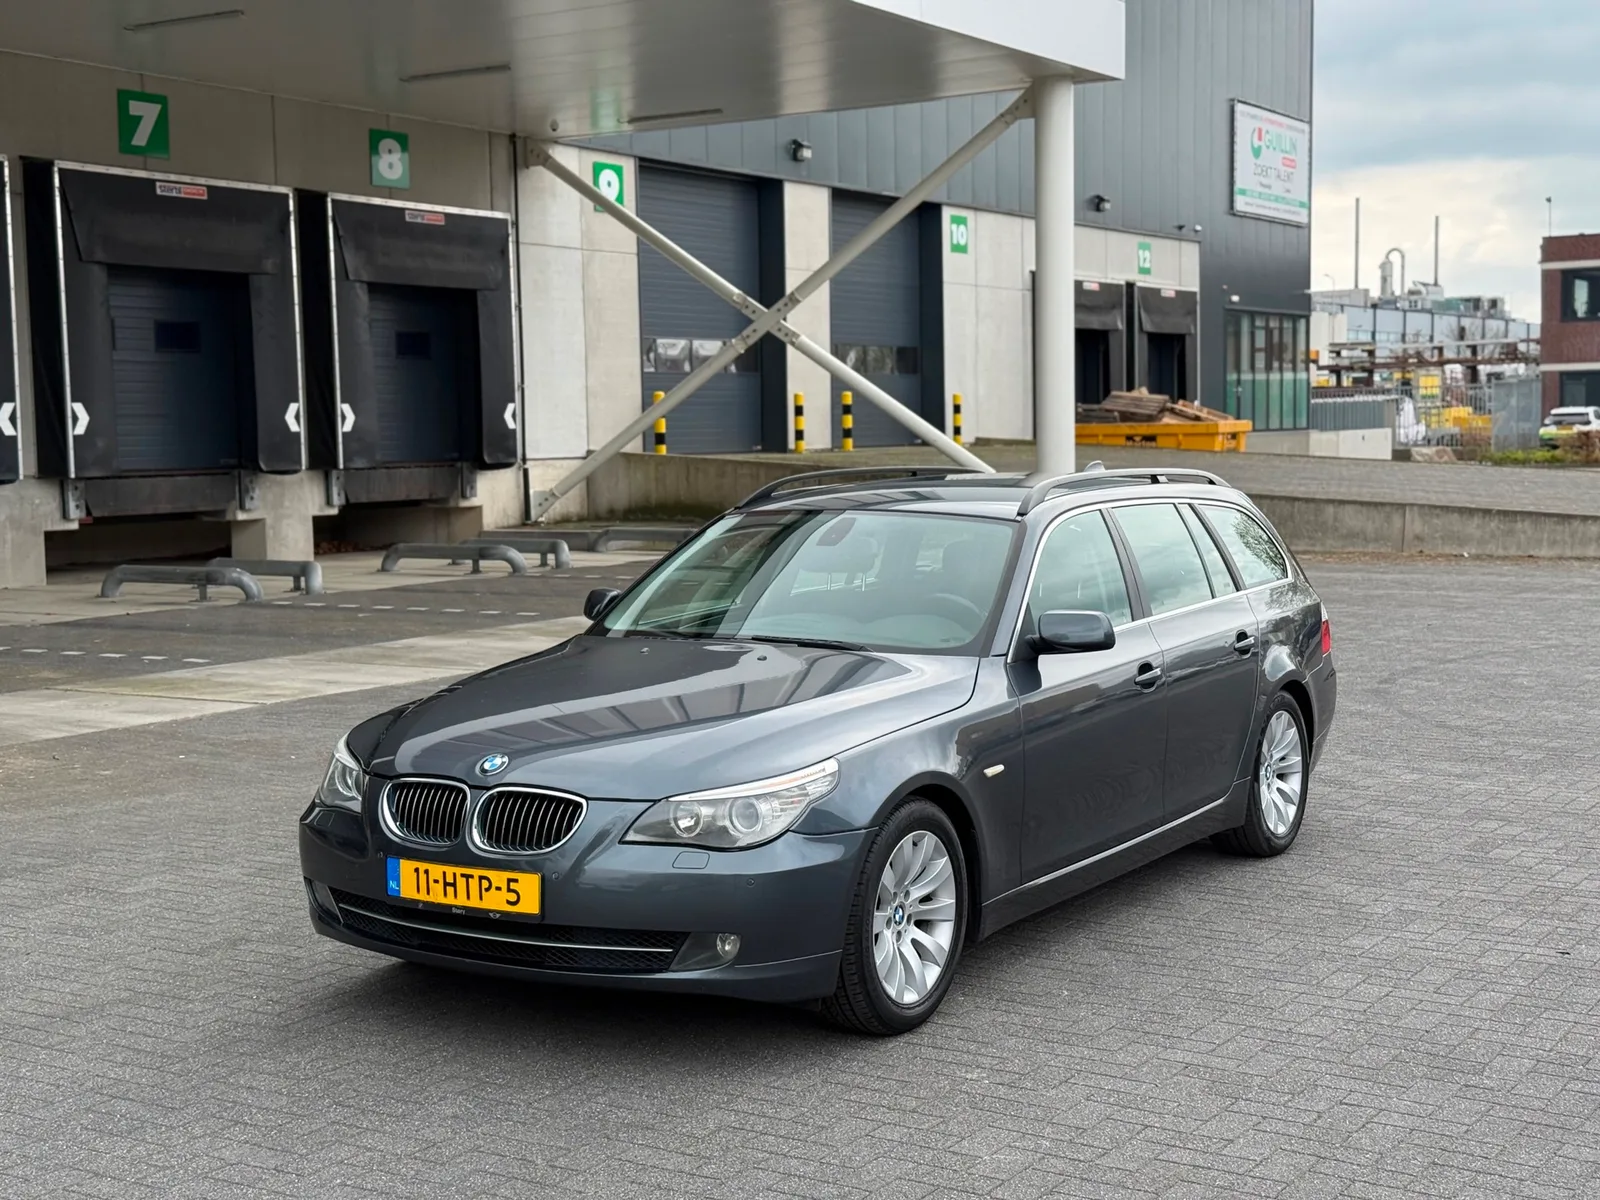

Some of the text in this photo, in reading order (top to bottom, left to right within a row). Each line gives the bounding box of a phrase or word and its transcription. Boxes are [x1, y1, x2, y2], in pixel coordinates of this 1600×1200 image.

[129, 100, 162, 147] 7
[378, 138, 403, 180] 8
[1264, 128, 1298, 157] GUILLIN
[599, 168, 620, 202] 9
[951, 223, 967, 246] 10
[1138, 249, 1151, 269] 12
[389, 866, 521, 907] NL 11-HTP-5
